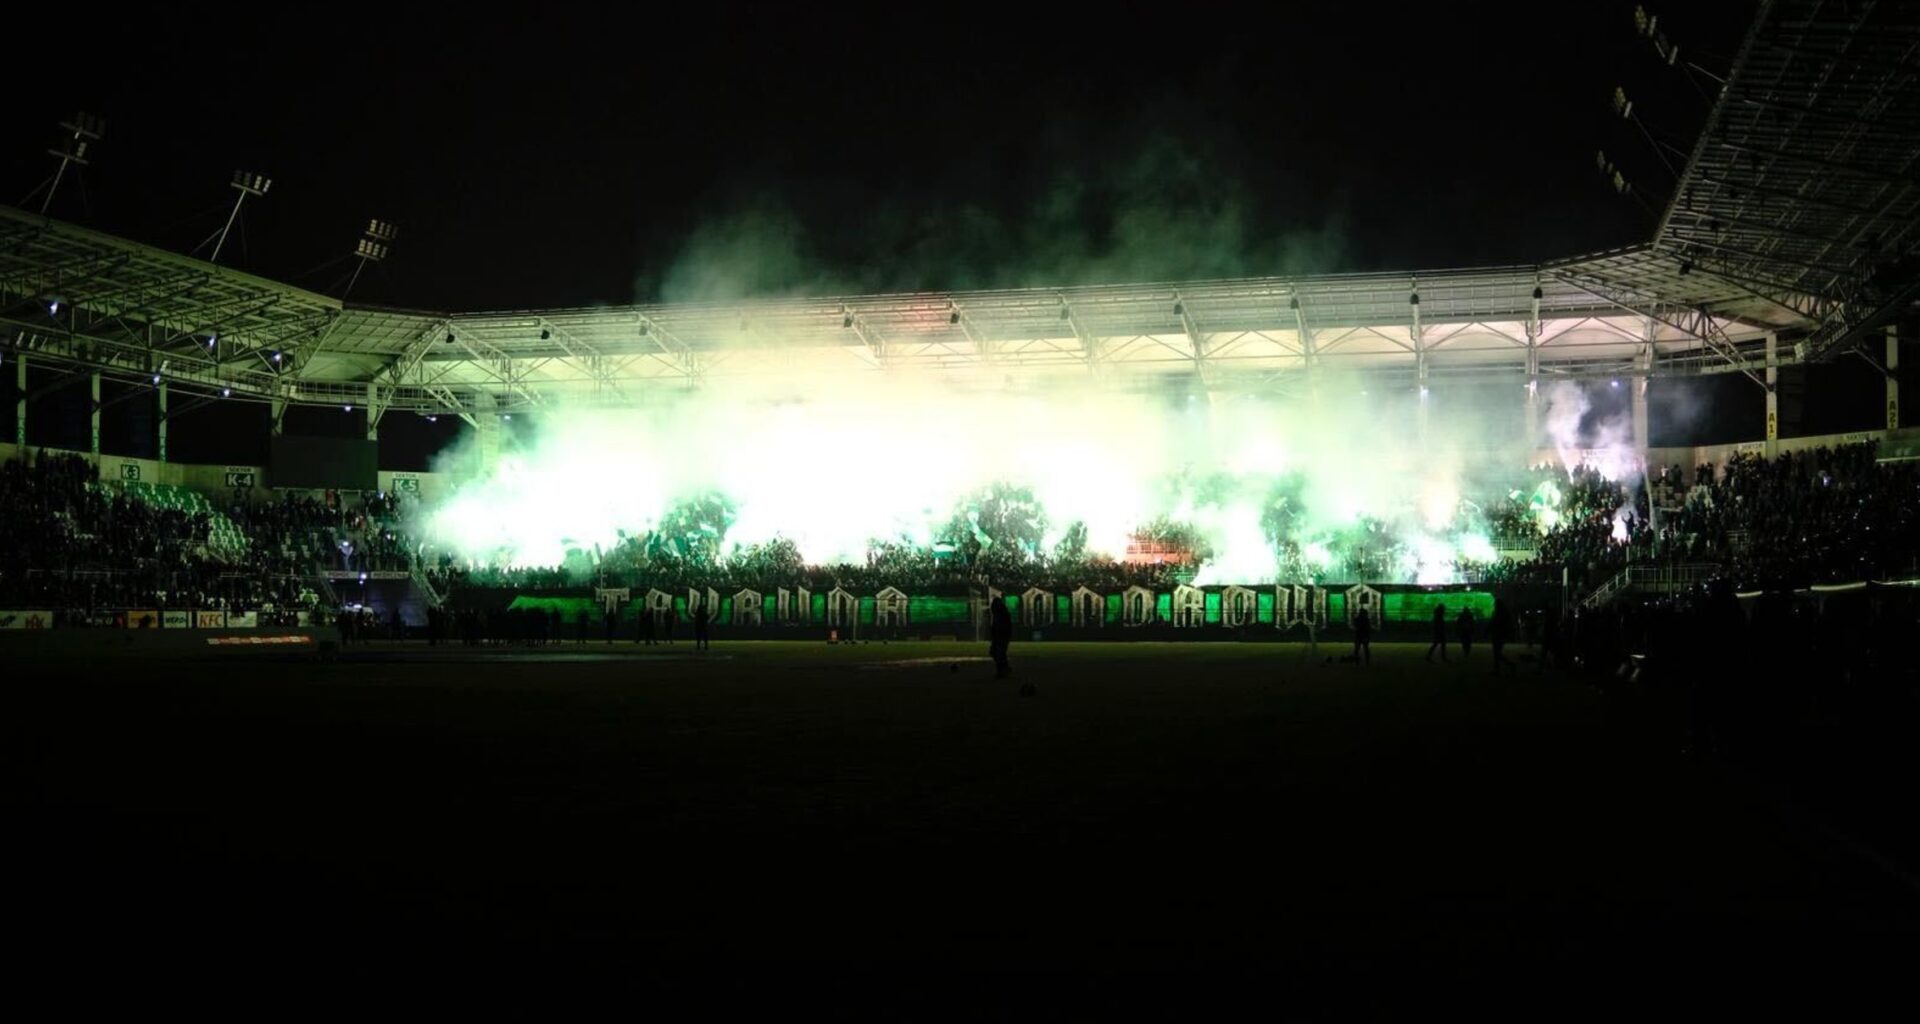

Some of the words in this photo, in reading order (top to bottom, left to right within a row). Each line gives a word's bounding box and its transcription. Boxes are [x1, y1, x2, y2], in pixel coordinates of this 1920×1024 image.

[122, 466, 138, 479] K-3
[227, 474, 252, 487] K-4
[395, 480, 416, 491] K-5
[199, 614, 223, 626] KFC
